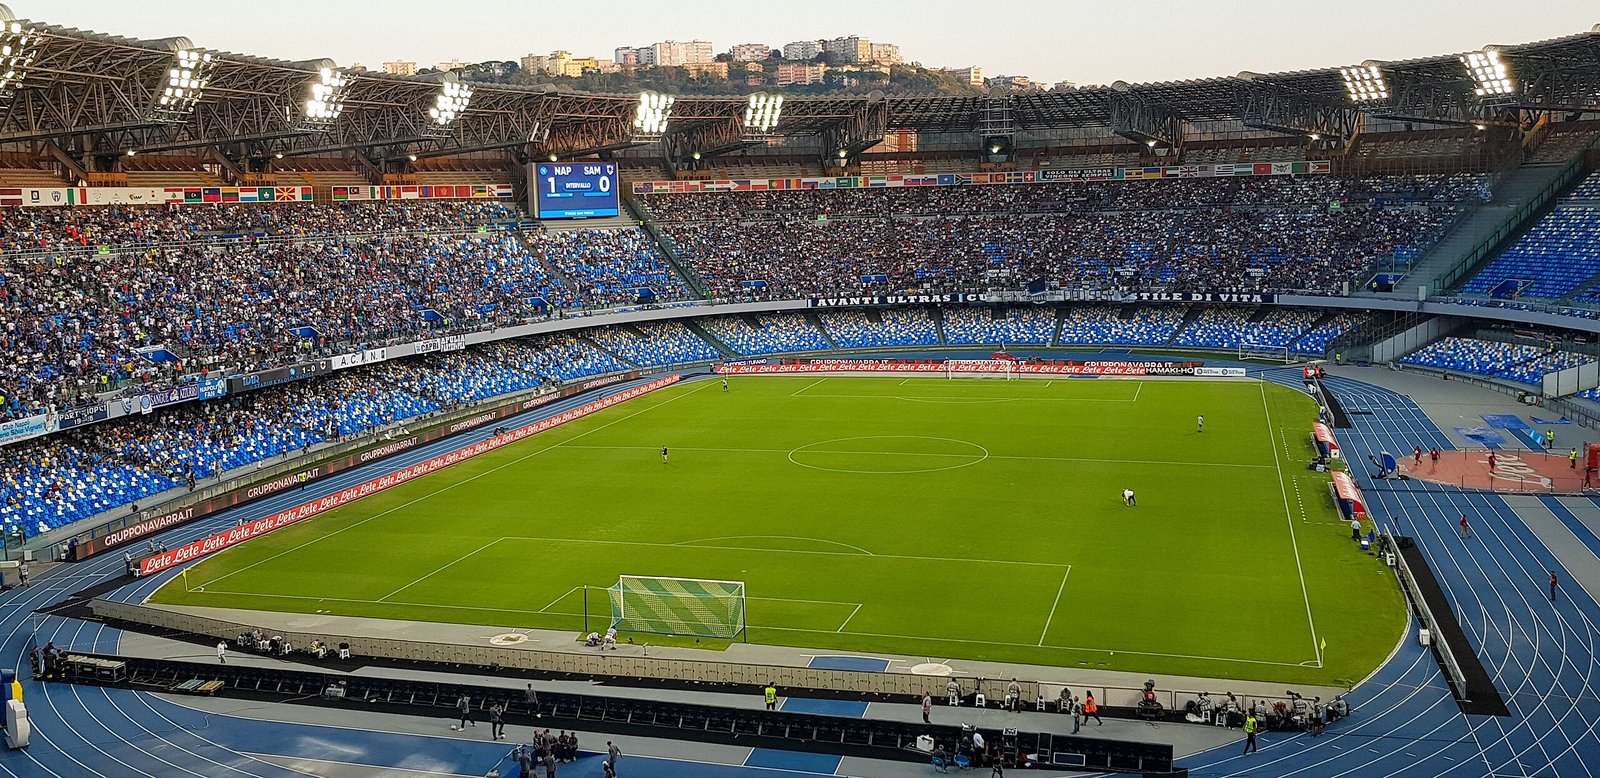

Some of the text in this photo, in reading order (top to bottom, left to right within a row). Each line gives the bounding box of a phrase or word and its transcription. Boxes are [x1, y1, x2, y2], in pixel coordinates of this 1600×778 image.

[554, 166, 600, 175] NAP SAM
[548, 176, 556, 193] 1
[599, 176, 610, 192] 0
[817, 294, 950, 307] AVANTI ULTRAS
[1192, 293, 1212, 301] DI
[1220, 294, 1262, 302] VITA
[441, 334, 465, 344] APULIA
[421, 342, 439, 352] CAPRI
[150, 392, 169, 405] SANGUE
[450, 412, 496, 432] GRUPPONAVARRA.IT
[360, 436, 418, 462] GRUPPONAVARRA.IT
[143, 556, 171, 573] Lete
[173, 546, 199, 562] Lete
[200, 536, 224, 553] Lete
[226, 527, 249, 543] Lete
[251, 519, 273, 535] Lete
[275, 511, 296, 526] Lete
[297, 503, 317, 518] Lete
[319, 496, 338, 510] Lete
[340, 489, 357, 502] Lete
[358, 482, 376, 496] Lete
[378, 476, 394, 489] Lete
[396, 469, 411, 482] Lete
[412, 463, 427, 476] Lete
[429, 458, 444, 470] Lete
[445, 453, 458, 464] Lete
[460, 448, 473, 459] Lete
[474, 443, 487, 454] Lete
[489, 437, 500, 448] Lete
[502, 432, 513, 444] Lete
[515, 428, 526, 439] Lete
[527, 424, 538, 434] Lete
[540, 419, 550, 430] Lete
[551, 415, 561, 426] Lete
[104, 508, 193, 547] GRUPPONAVARRA.IT
